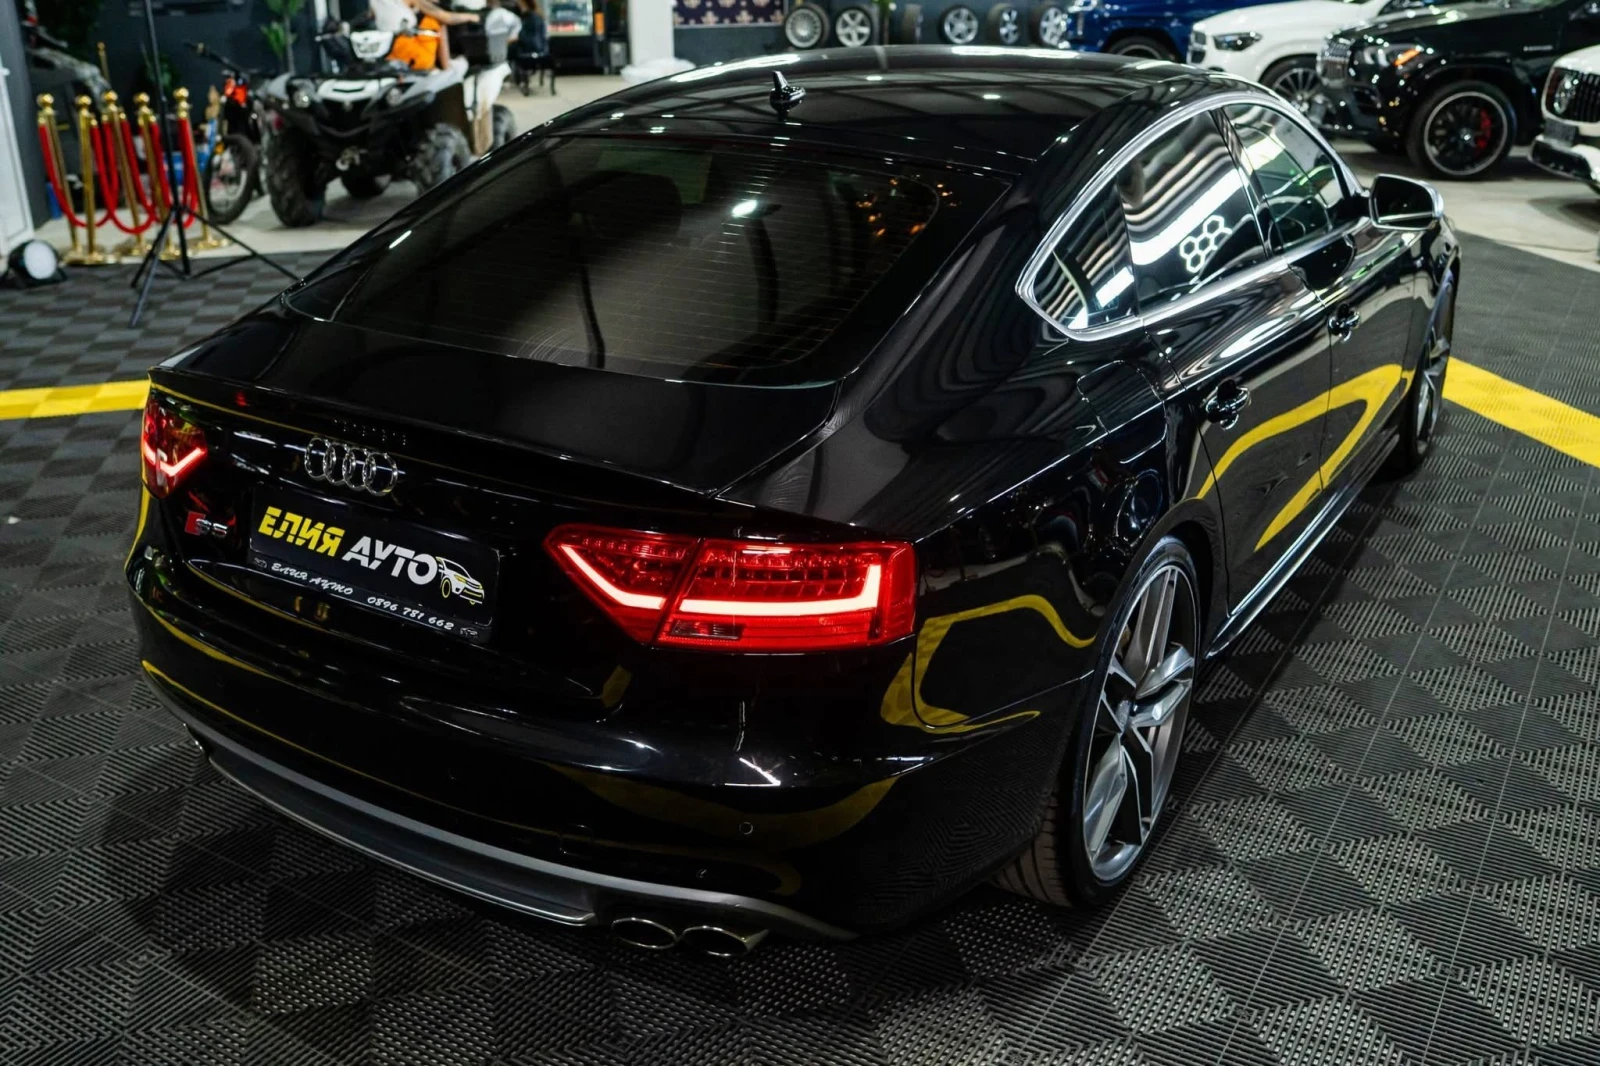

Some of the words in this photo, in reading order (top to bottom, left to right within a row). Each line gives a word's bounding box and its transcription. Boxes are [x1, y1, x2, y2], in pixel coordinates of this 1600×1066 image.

[258, 506, 345, 557] ЕЛИЯ
[341, 535, 438, 585] АУТО
[367, 596, 399, 611] 0896
[402, 607, 425, 620] 781
[428, 616, 455, 631] 662
